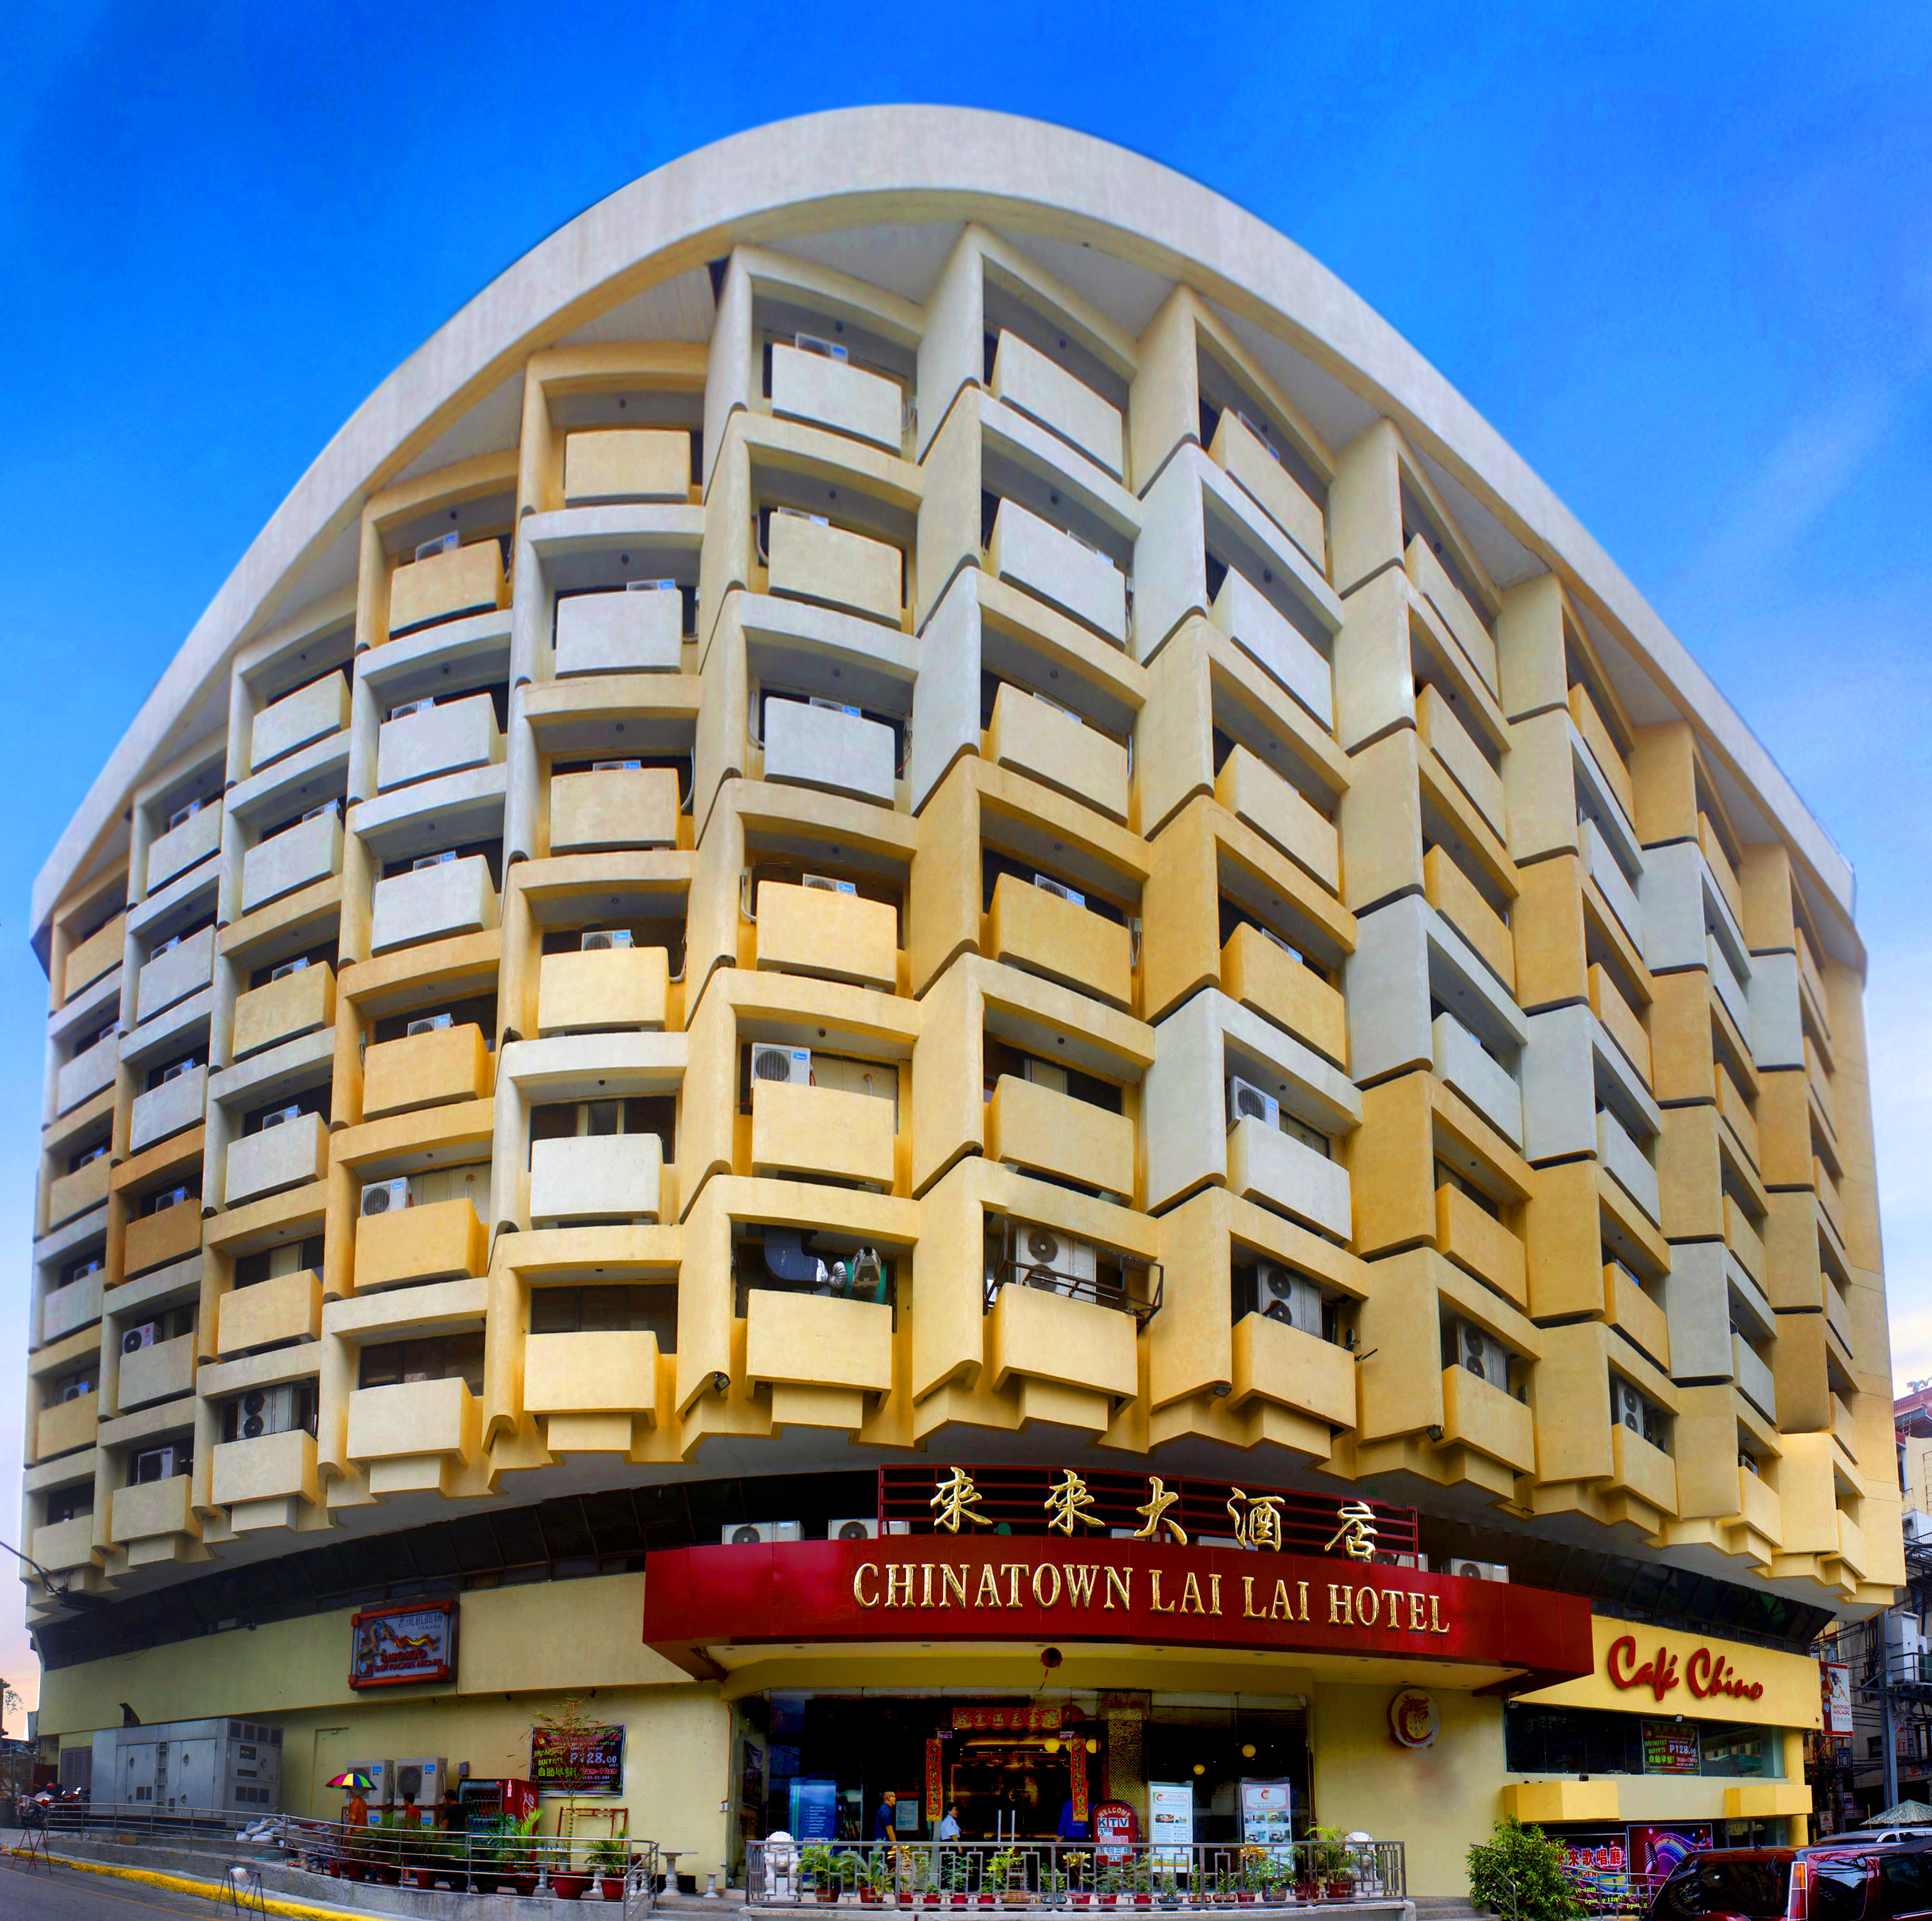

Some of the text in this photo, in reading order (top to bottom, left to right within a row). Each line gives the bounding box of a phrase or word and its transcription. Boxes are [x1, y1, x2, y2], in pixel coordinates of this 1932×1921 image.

[853, 1563, 1450, 1634] CHINATOWN LAI LAI HOTEL
[380, 1649, 427, 1663] BINONDO
[1608, 1635, 1764, 1701] Café Chino
[1097, 1807, 1131, 1817] WELCOME
[1098, 1818, 1128, 1827] KTV
[1098, 1828, 1112, 1836] 3RD
